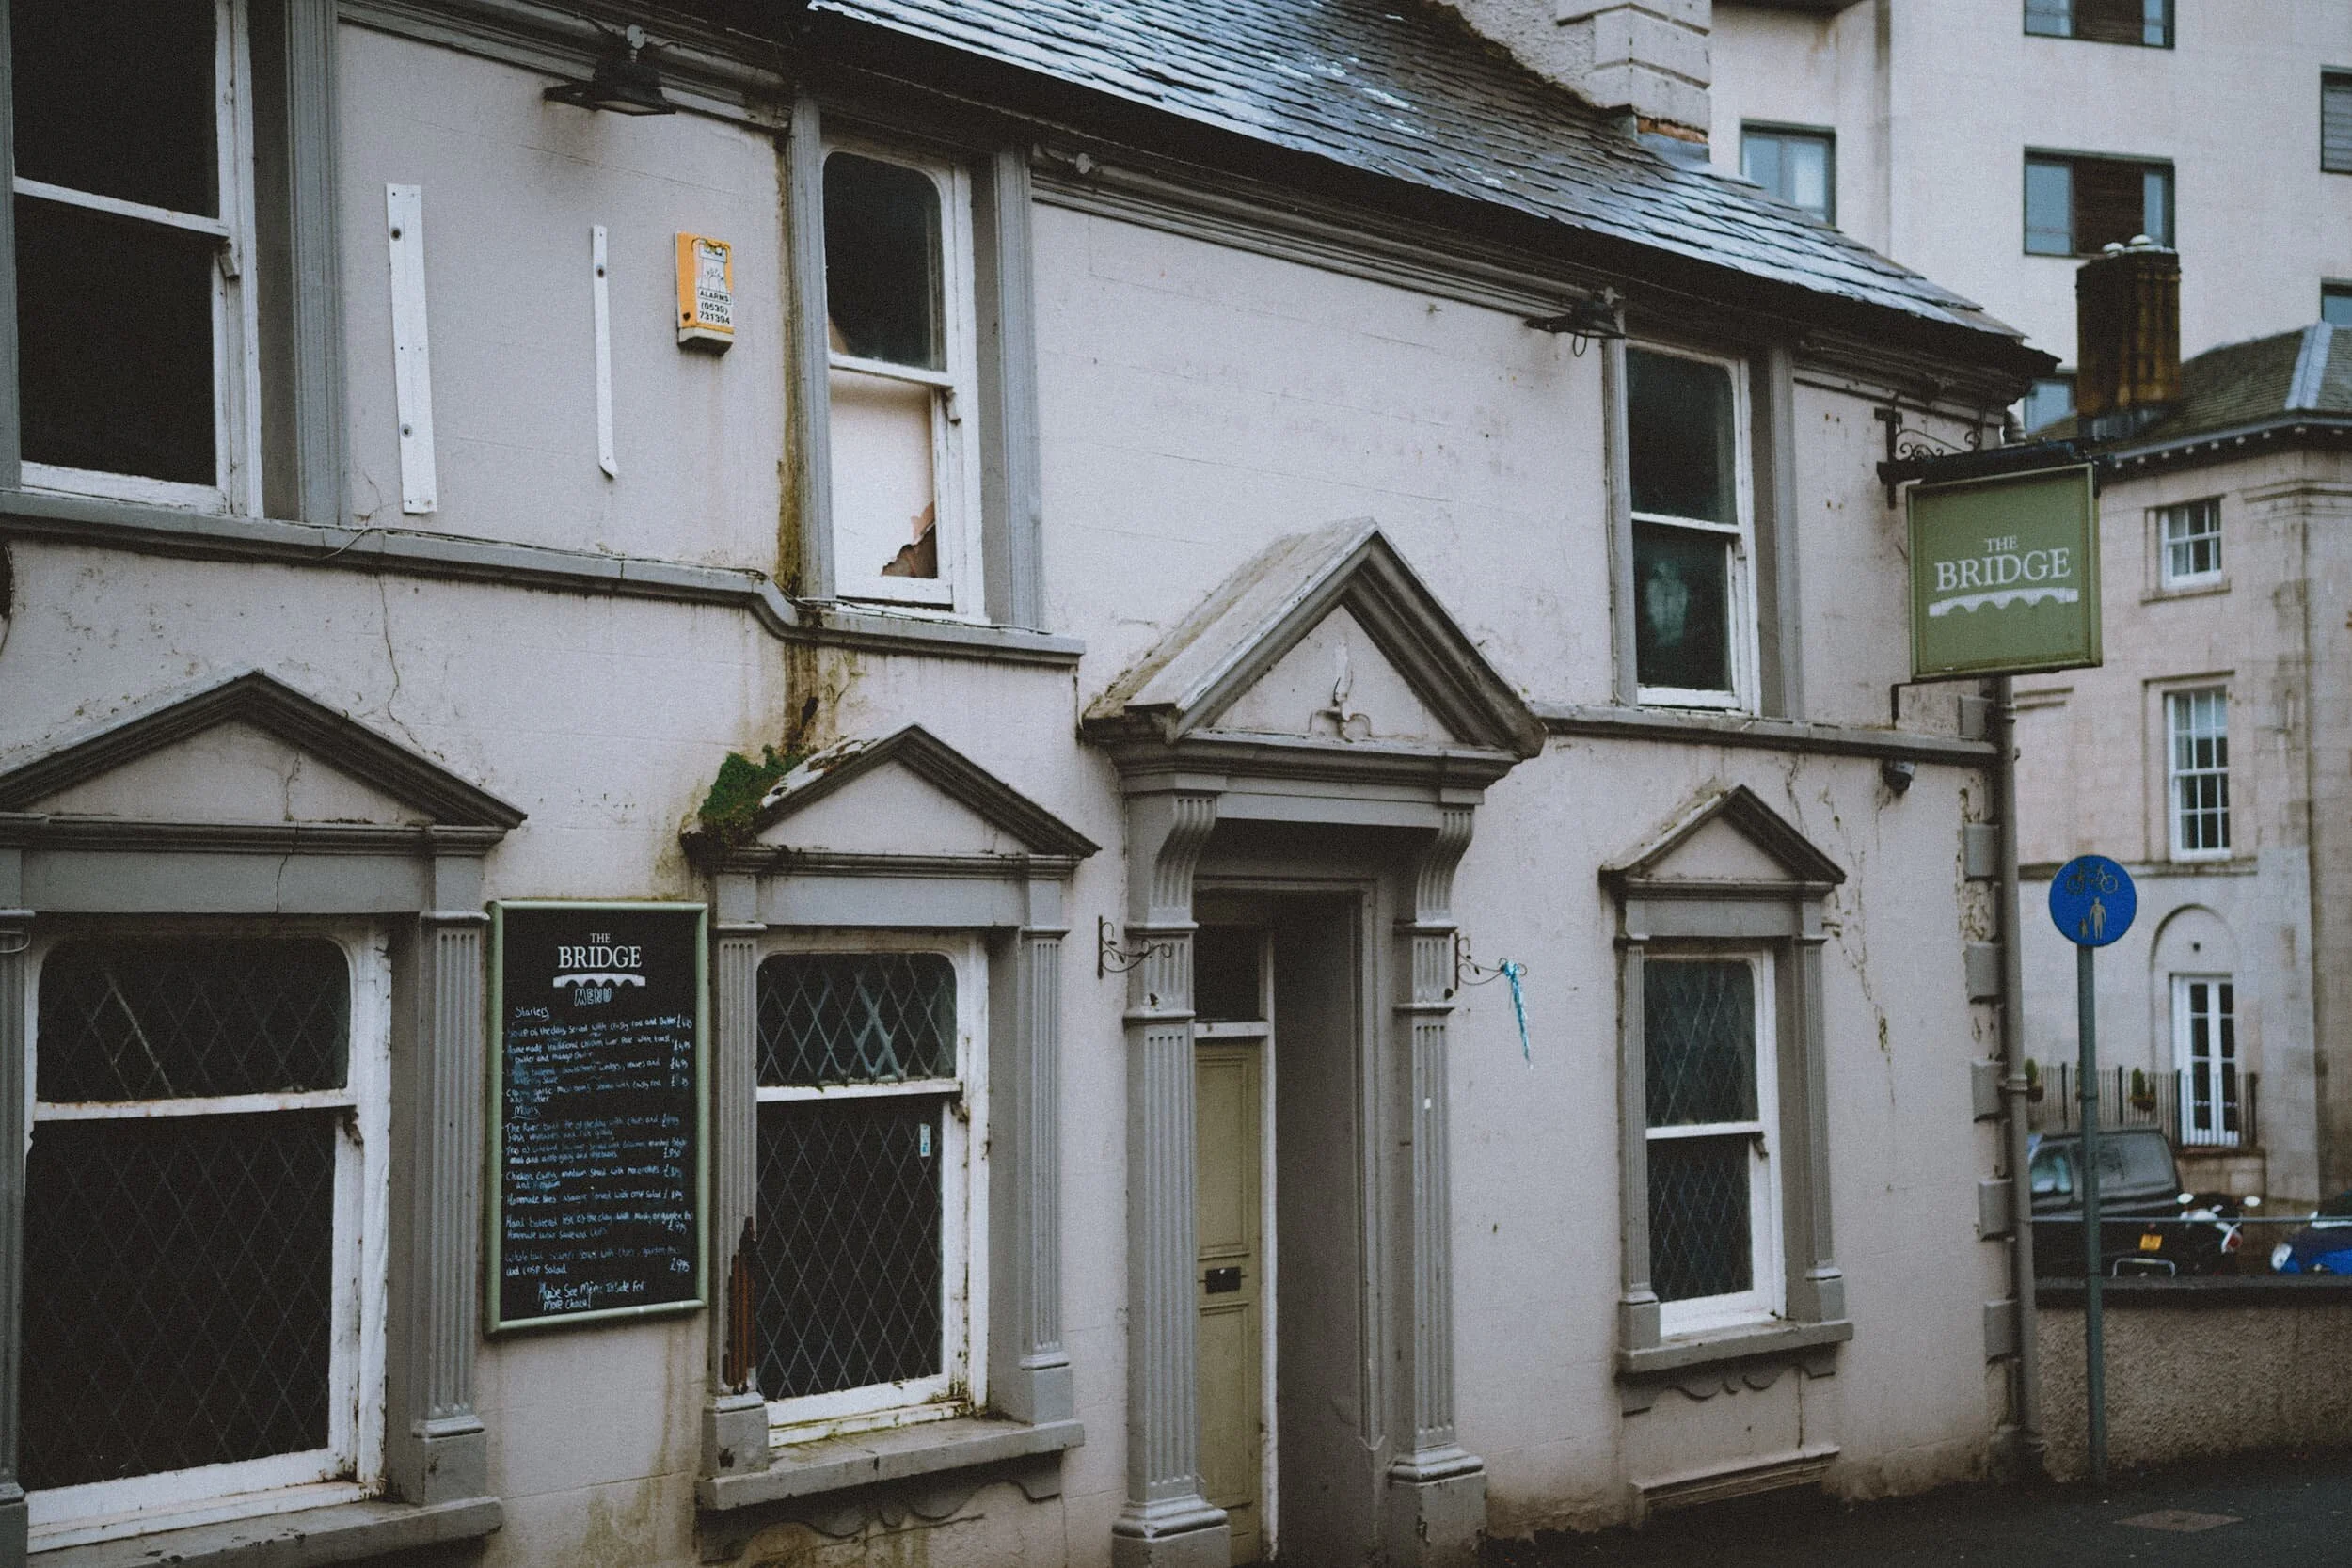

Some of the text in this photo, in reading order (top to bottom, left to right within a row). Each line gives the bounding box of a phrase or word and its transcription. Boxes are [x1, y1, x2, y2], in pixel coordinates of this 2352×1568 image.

[700, 290, 729, 302] ALARMS
[1985, 535, 2018, 553] THE
[1934, 547, 2071, 592] BRIDGE
[590, 933, 611, 943] THE
[558, 945, 642, 969] BRIDGE
[574, 988, 612, 1007] MENU
